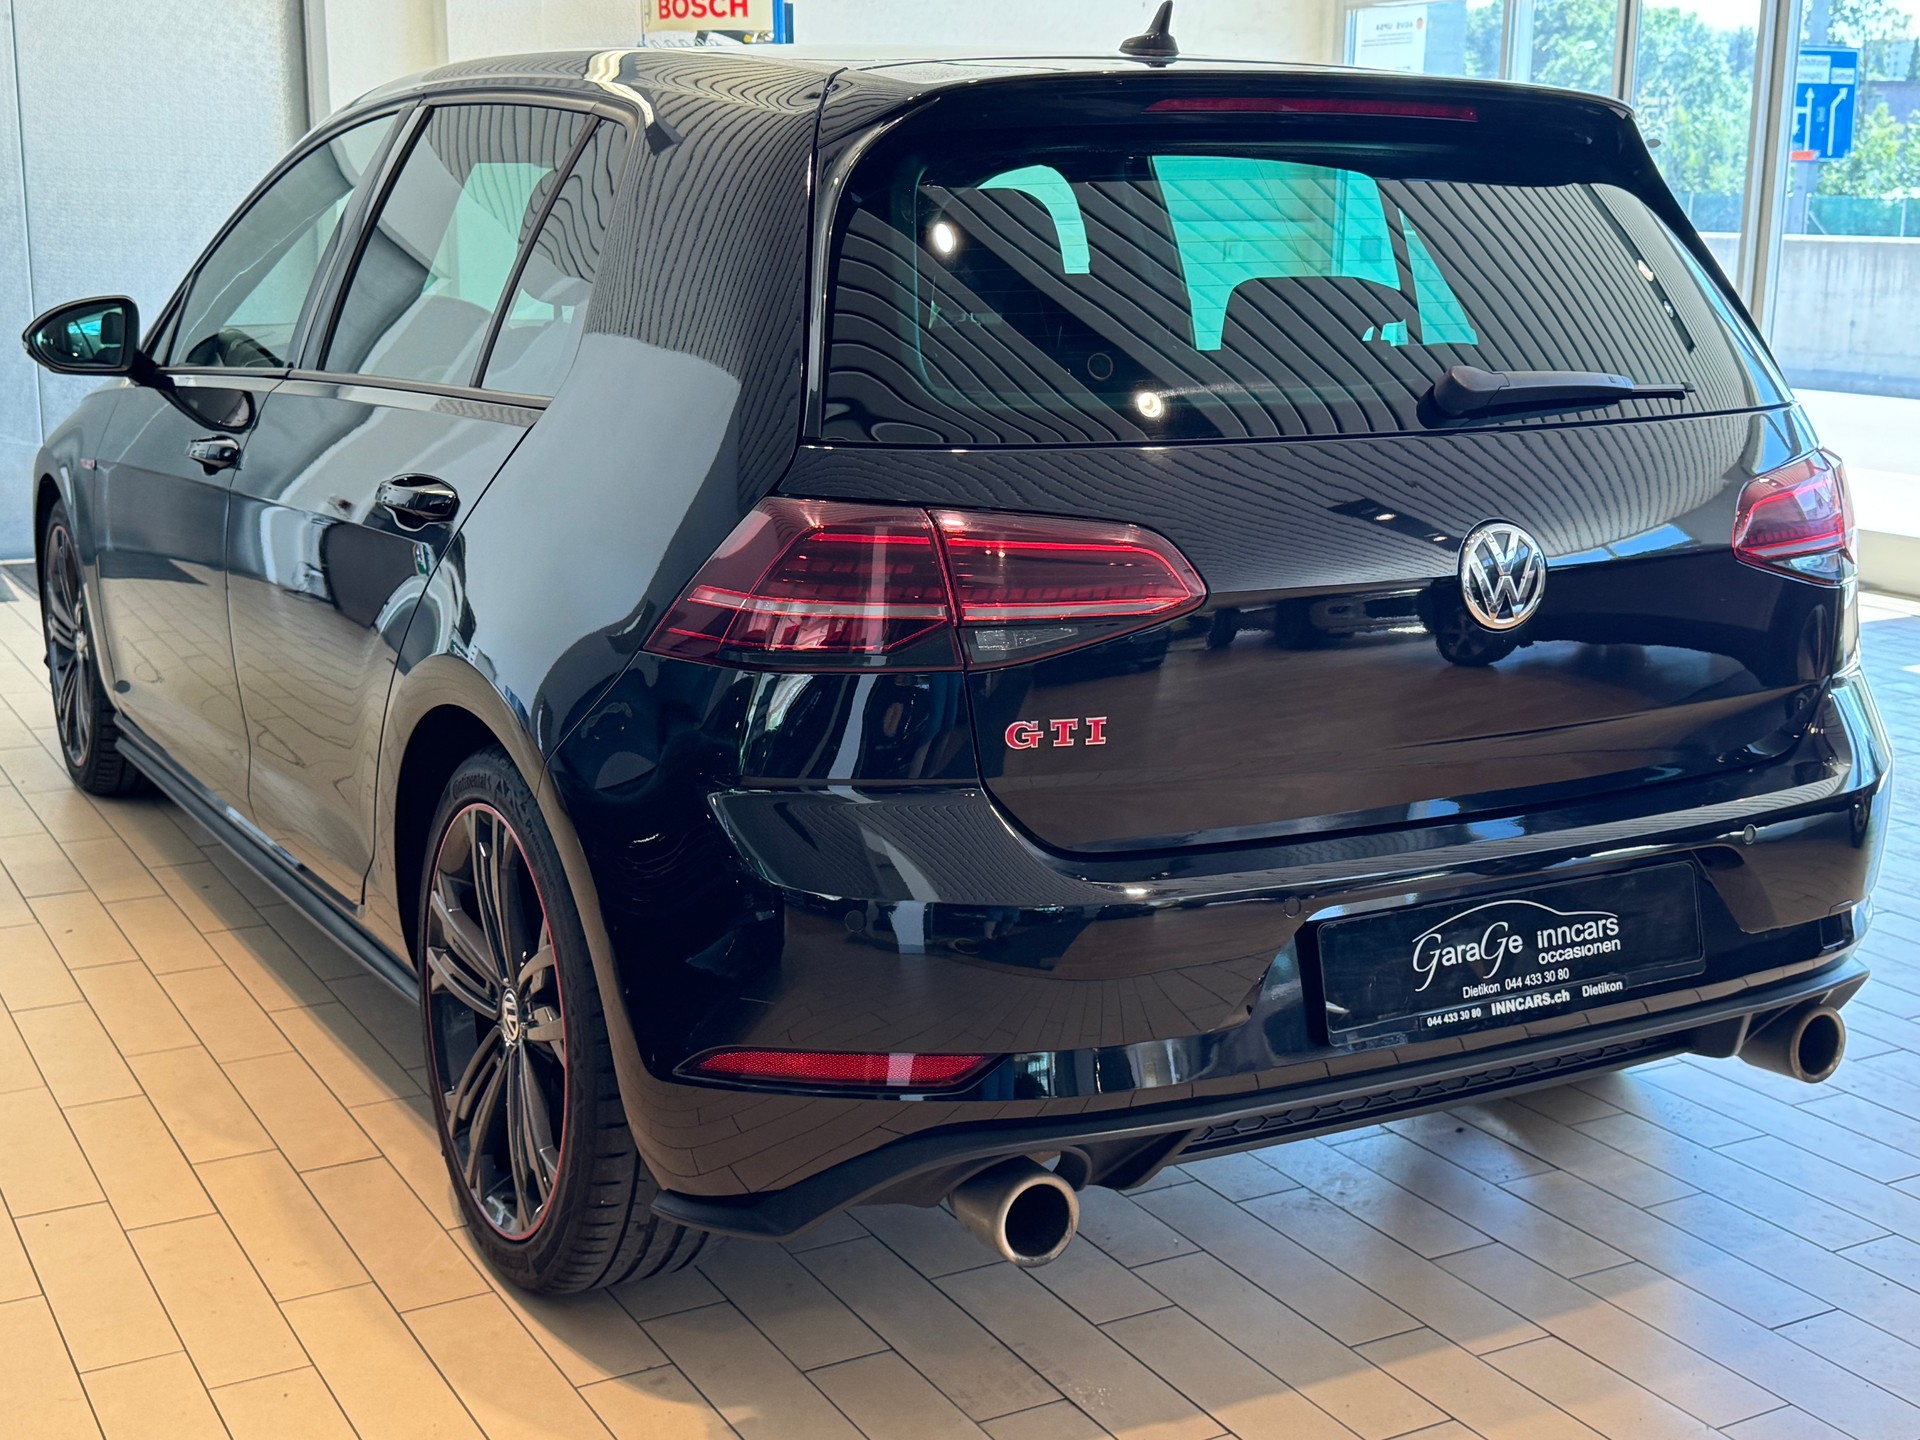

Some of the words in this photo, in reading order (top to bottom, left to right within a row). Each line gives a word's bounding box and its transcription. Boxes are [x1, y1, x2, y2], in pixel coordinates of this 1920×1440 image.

[658, 0, 749, 19] BOSCH
[1004, 716, 1108, 750] GTI
[1412, 921, 1523, 992] GaraGe
[1537, 917, 1619, 949] inncars
[1538, 938, 1621, 965] occasionen
[1462, 982, 1500, 999] Dietikon
[1504, 978, 1523, 991] 044
[1525, 974, 1543, 986] 433
[1544, 970, 1556, 982] 30
[1557, 967, 1570, 980] 80
[1427, 1014, 1442, 1027] 044
[1443, 1011, 1458, 1023] 433
[1459, 1009, 1470, 1021] 30
[1471, 1007, 1482, 1018] 80
[1491, 989, 1570, 1016] INNCARS.ch
[1582, 980, 1623, 998] Dietikon
